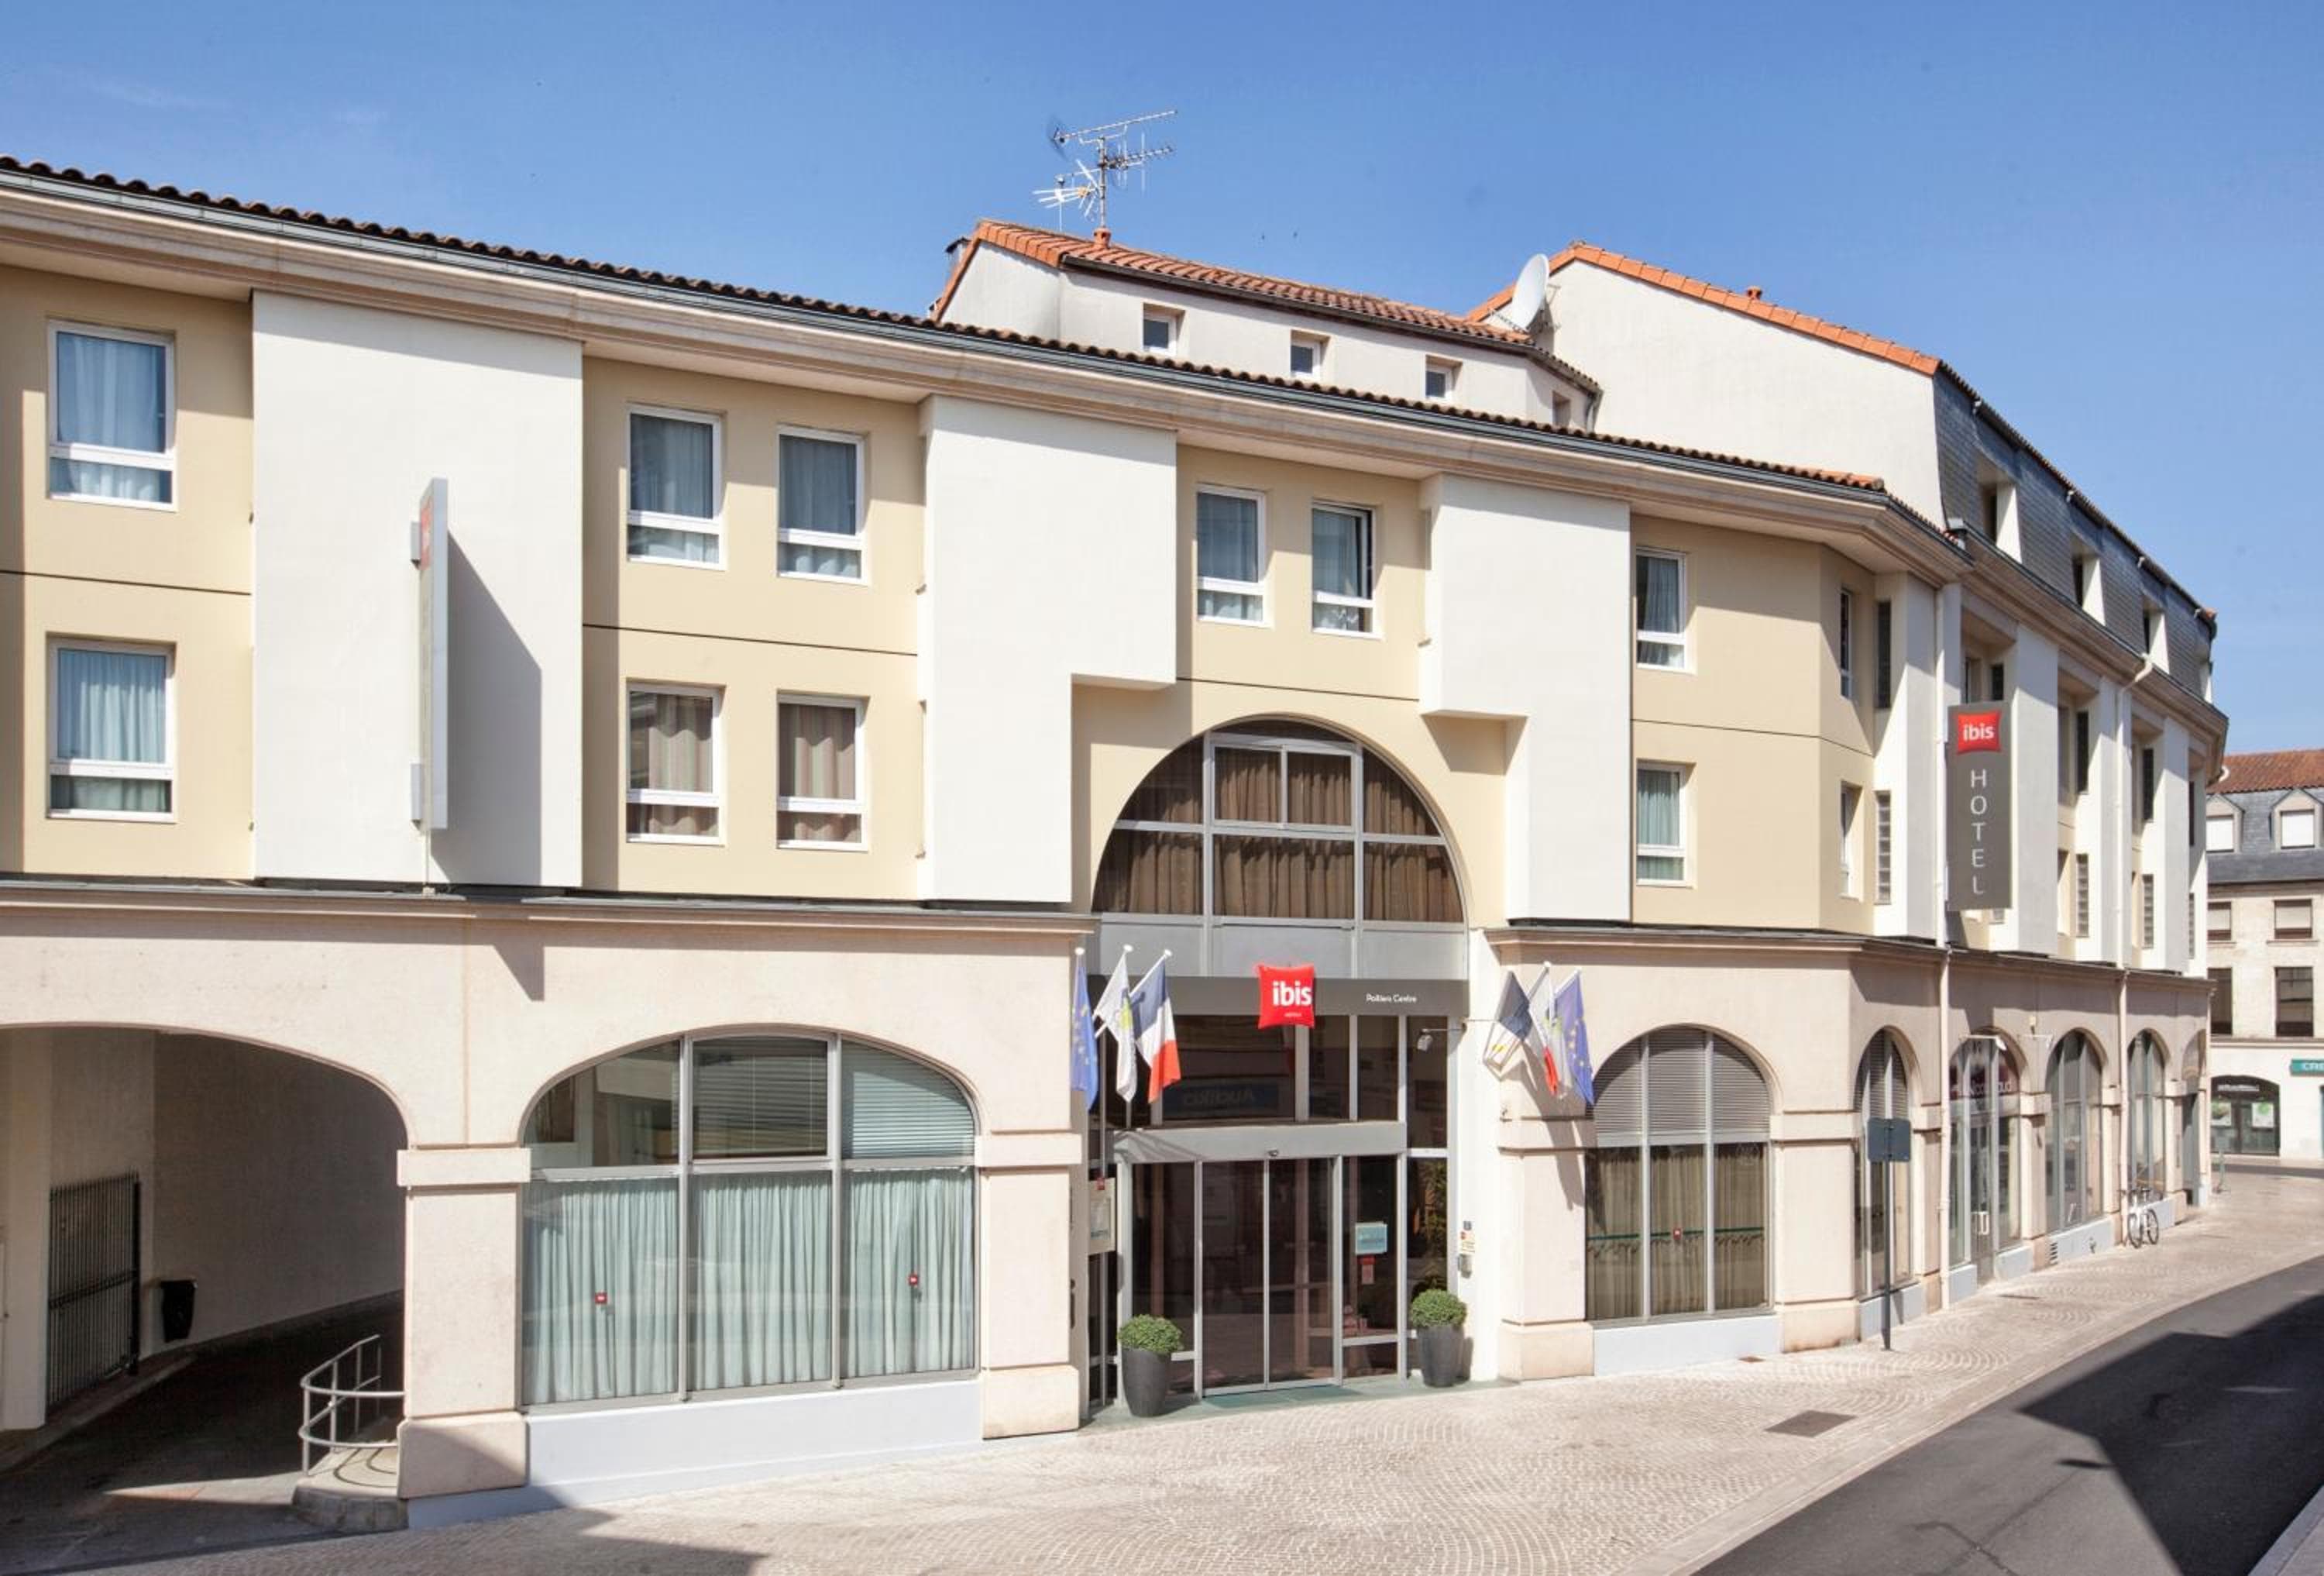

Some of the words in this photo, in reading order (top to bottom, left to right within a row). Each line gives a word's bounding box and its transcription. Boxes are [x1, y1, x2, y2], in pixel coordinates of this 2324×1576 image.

[1963, 722, 1995, 742] ibis
[1970, 769, 1987, 894] HOTEL
[1273, 980, 1312, 1007] ibis
